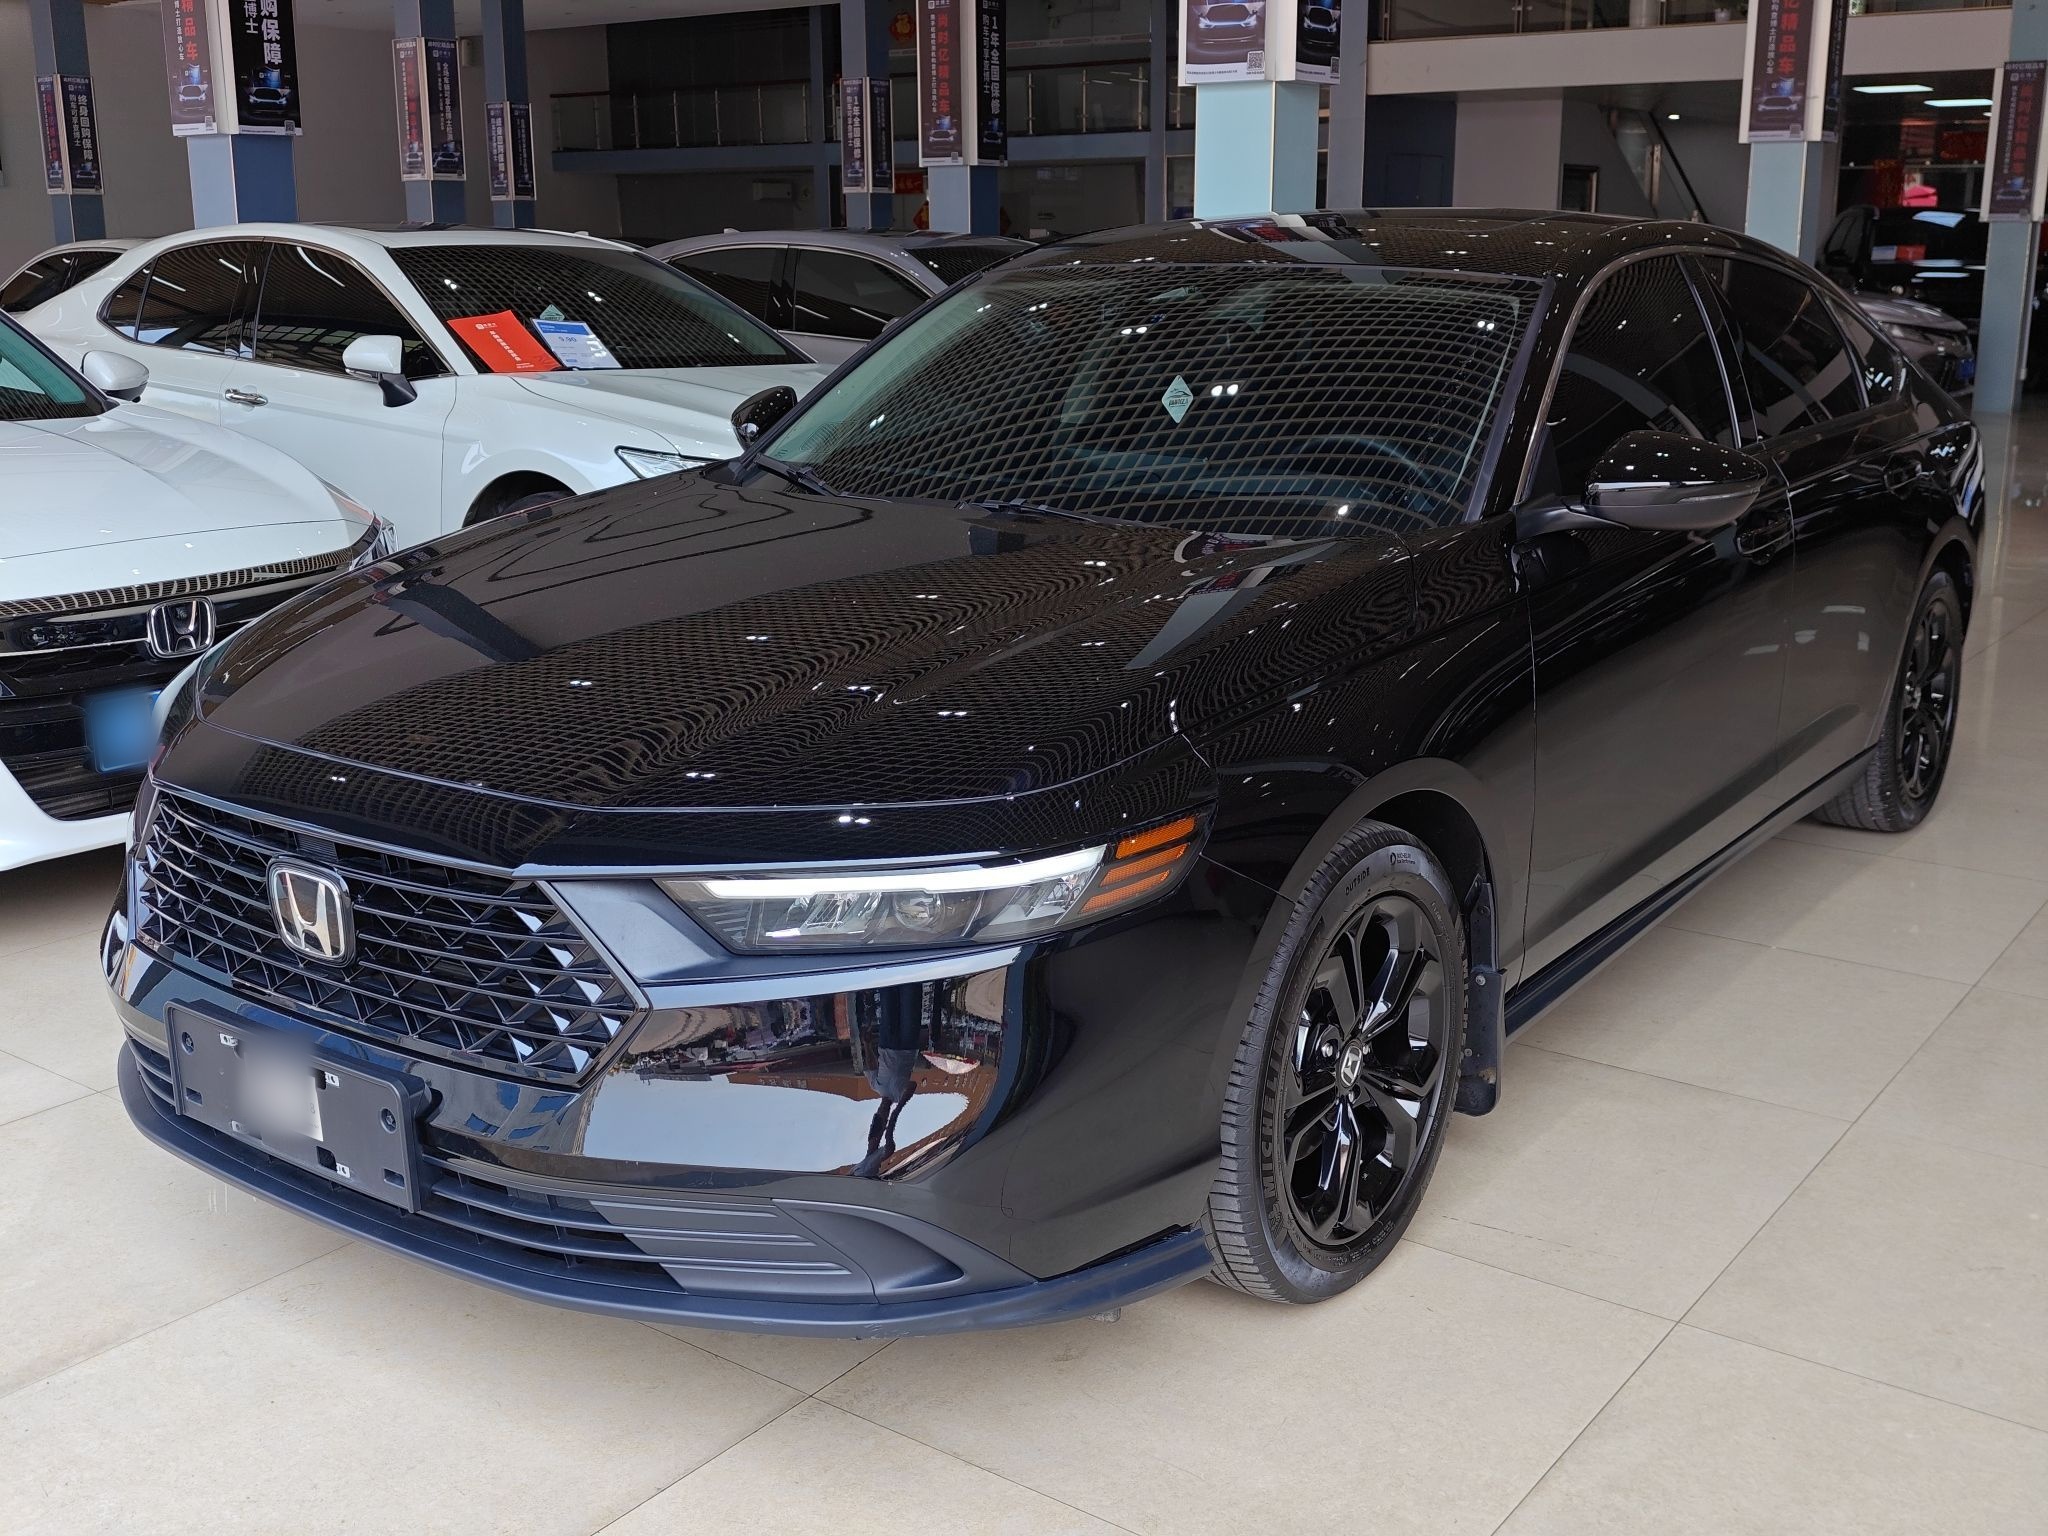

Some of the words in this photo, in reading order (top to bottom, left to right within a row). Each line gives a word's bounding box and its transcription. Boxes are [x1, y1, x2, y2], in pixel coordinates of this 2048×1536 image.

[260, 0, 282, 65] 购保障
[77, 94, 94, 161] 终身回购保障
[1345, 867, 1371, 896] OUTSIDE
[1261, 1028, 1286, 1200] MICHELIN
